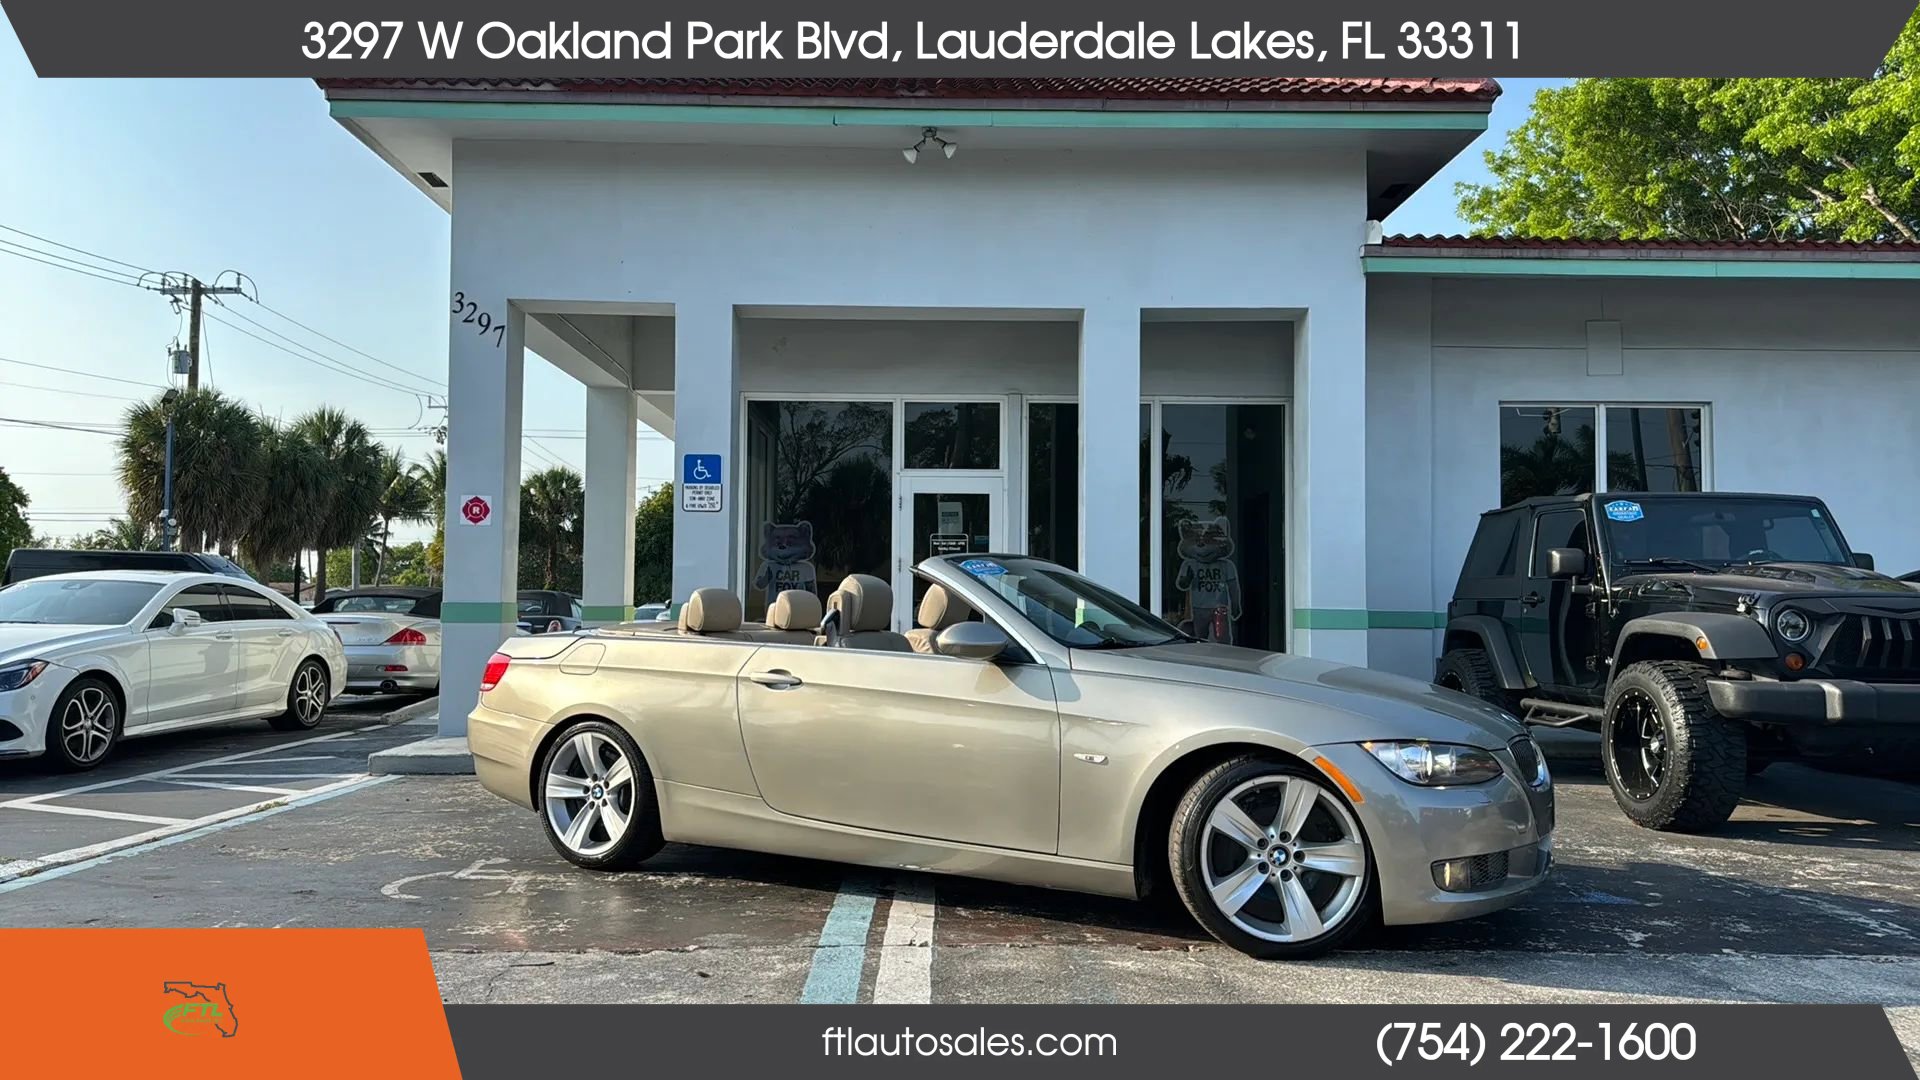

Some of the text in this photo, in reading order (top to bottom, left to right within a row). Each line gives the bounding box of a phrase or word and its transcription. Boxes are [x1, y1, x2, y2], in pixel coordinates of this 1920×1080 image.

[452, 291, 506, 348] 3297
[472, 506, 480, 515] R
[776, 569, 800, 581] CAR
[1197, 568, 1221, 580] CAR
[1198, 581, 1221, 592] FOX
